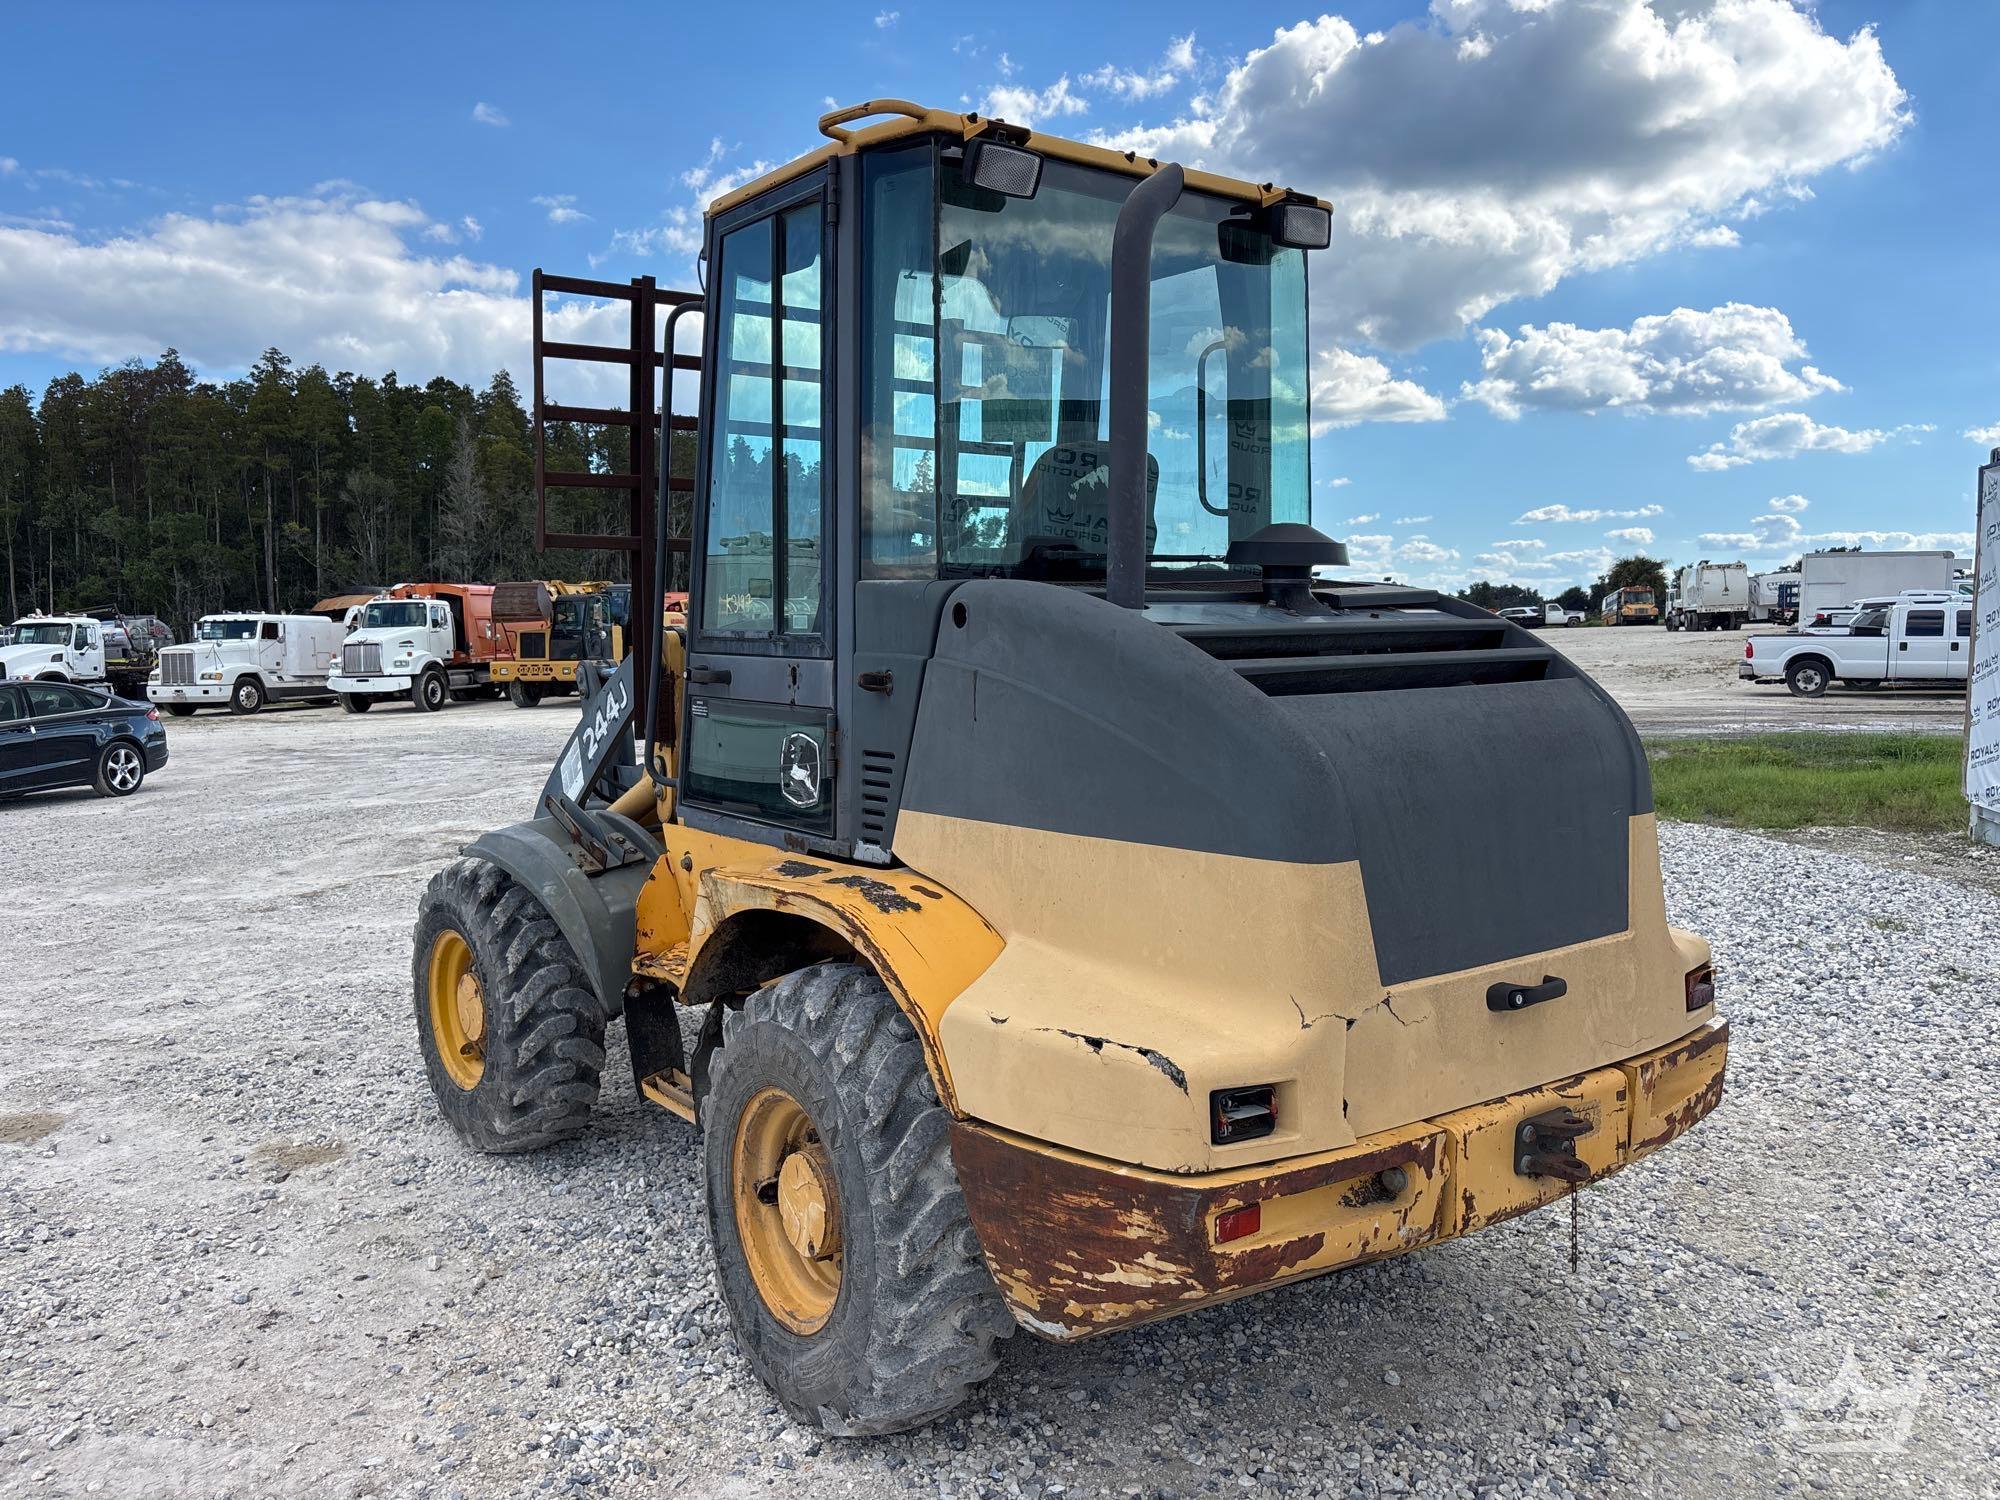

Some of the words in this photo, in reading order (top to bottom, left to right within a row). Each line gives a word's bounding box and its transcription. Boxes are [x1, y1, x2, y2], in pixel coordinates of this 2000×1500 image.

[1986, 608, 2000, 624] ROY
[1987, 696, 2000, 712] ROY
[582, 680, 628, 761] 244J
[1970, 743, 1994, 761] ROYAL
[1985, 785, 2000, 799] ROY
